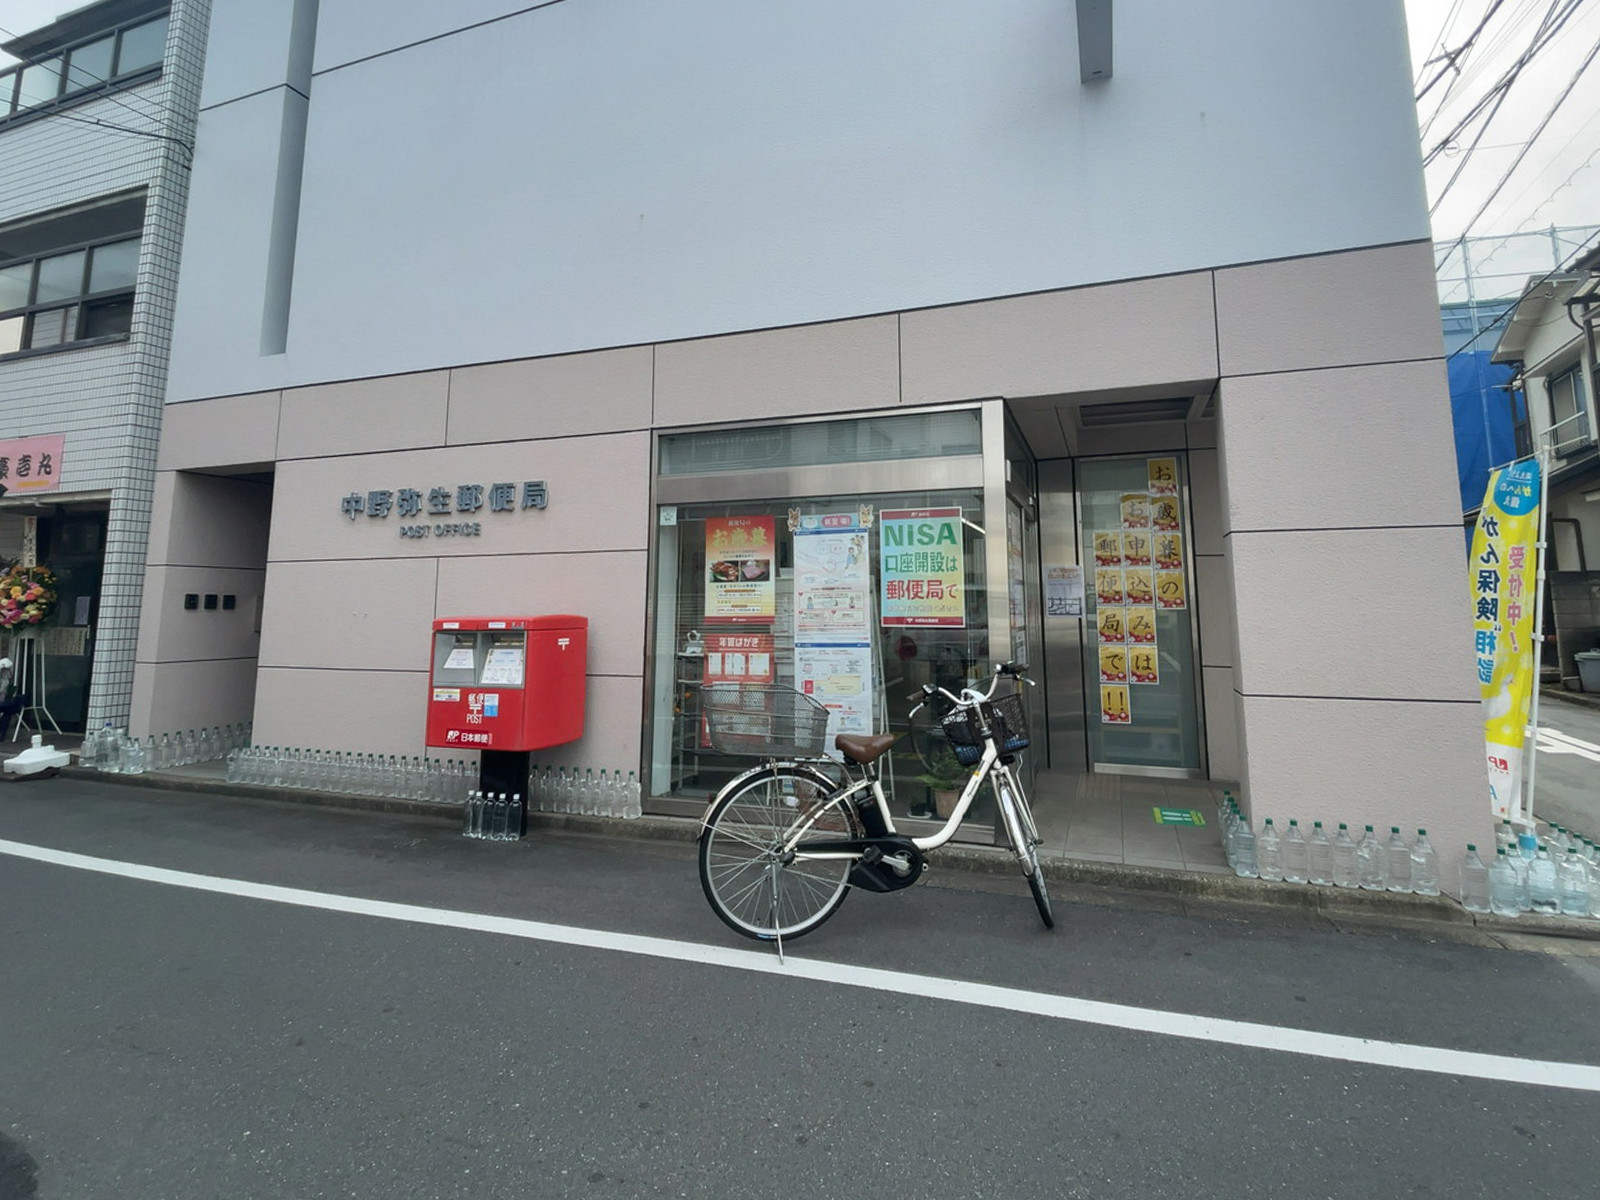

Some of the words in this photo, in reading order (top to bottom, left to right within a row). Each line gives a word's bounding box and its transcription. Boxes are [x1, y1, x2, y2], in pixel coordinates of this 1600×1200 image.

[341, 480, 549, 521] 中野弥生郵便局
[400, 524, 430, 538] POST
[434, 522, 481, 537] OFFICE
[884, 522, 957, 546] NISA
[885, 552, 958, 573] 口座開設は
[886, 579, 959, 600] 郵便局で
[719, 637, 759, 648] 年賀はがき
[466, 714, 482, 724] POST
[461, 732, 488, 744] 日本郵便
